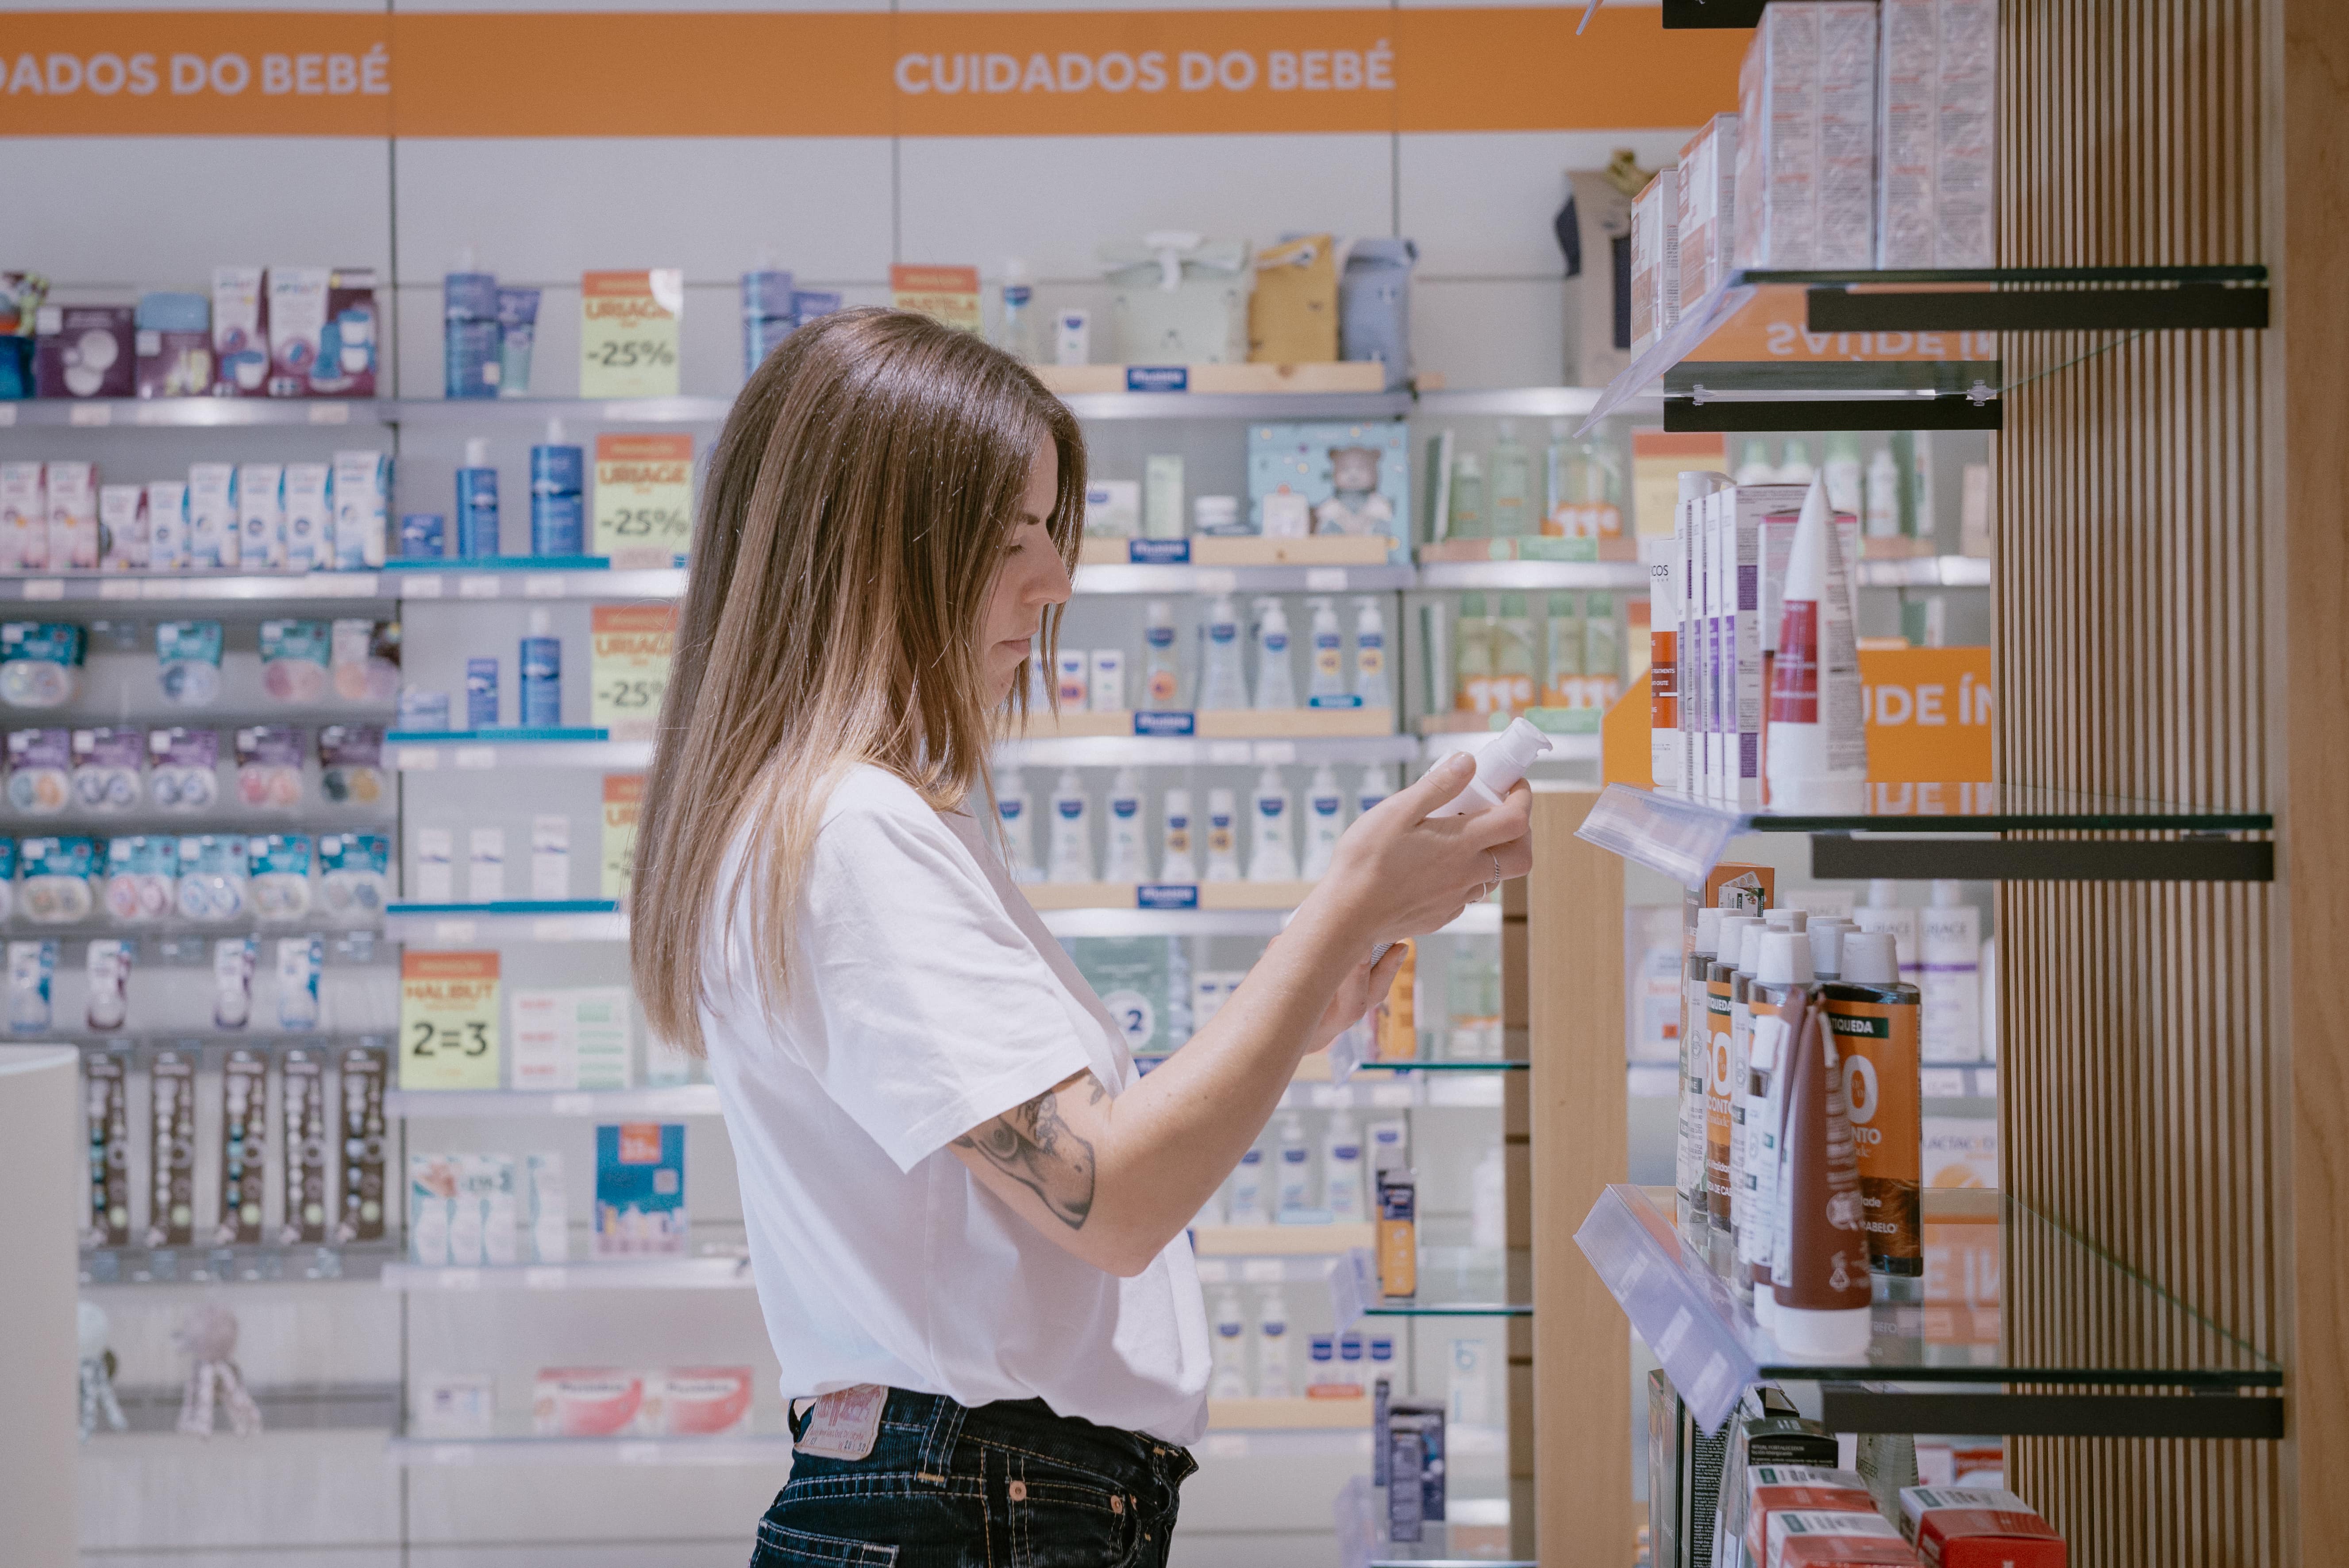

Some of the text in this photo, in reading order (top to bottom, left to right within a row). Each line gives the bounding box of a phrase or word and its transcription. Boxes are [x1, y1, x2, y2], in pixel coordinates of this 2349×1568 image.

[0, 43, 390, 95] ADOS DO BEBÉ
[895, 40, 1395, 93] CUIDADOS DO BEBÉ
[586, 340, 674, 366] -25%
[601, 509, 689, 534] -25%
[1651, 565, 1668, 576] COS
[1128, 1009, 1142, 1032] 2
[413, 1021, 487, 1056] 2=3
